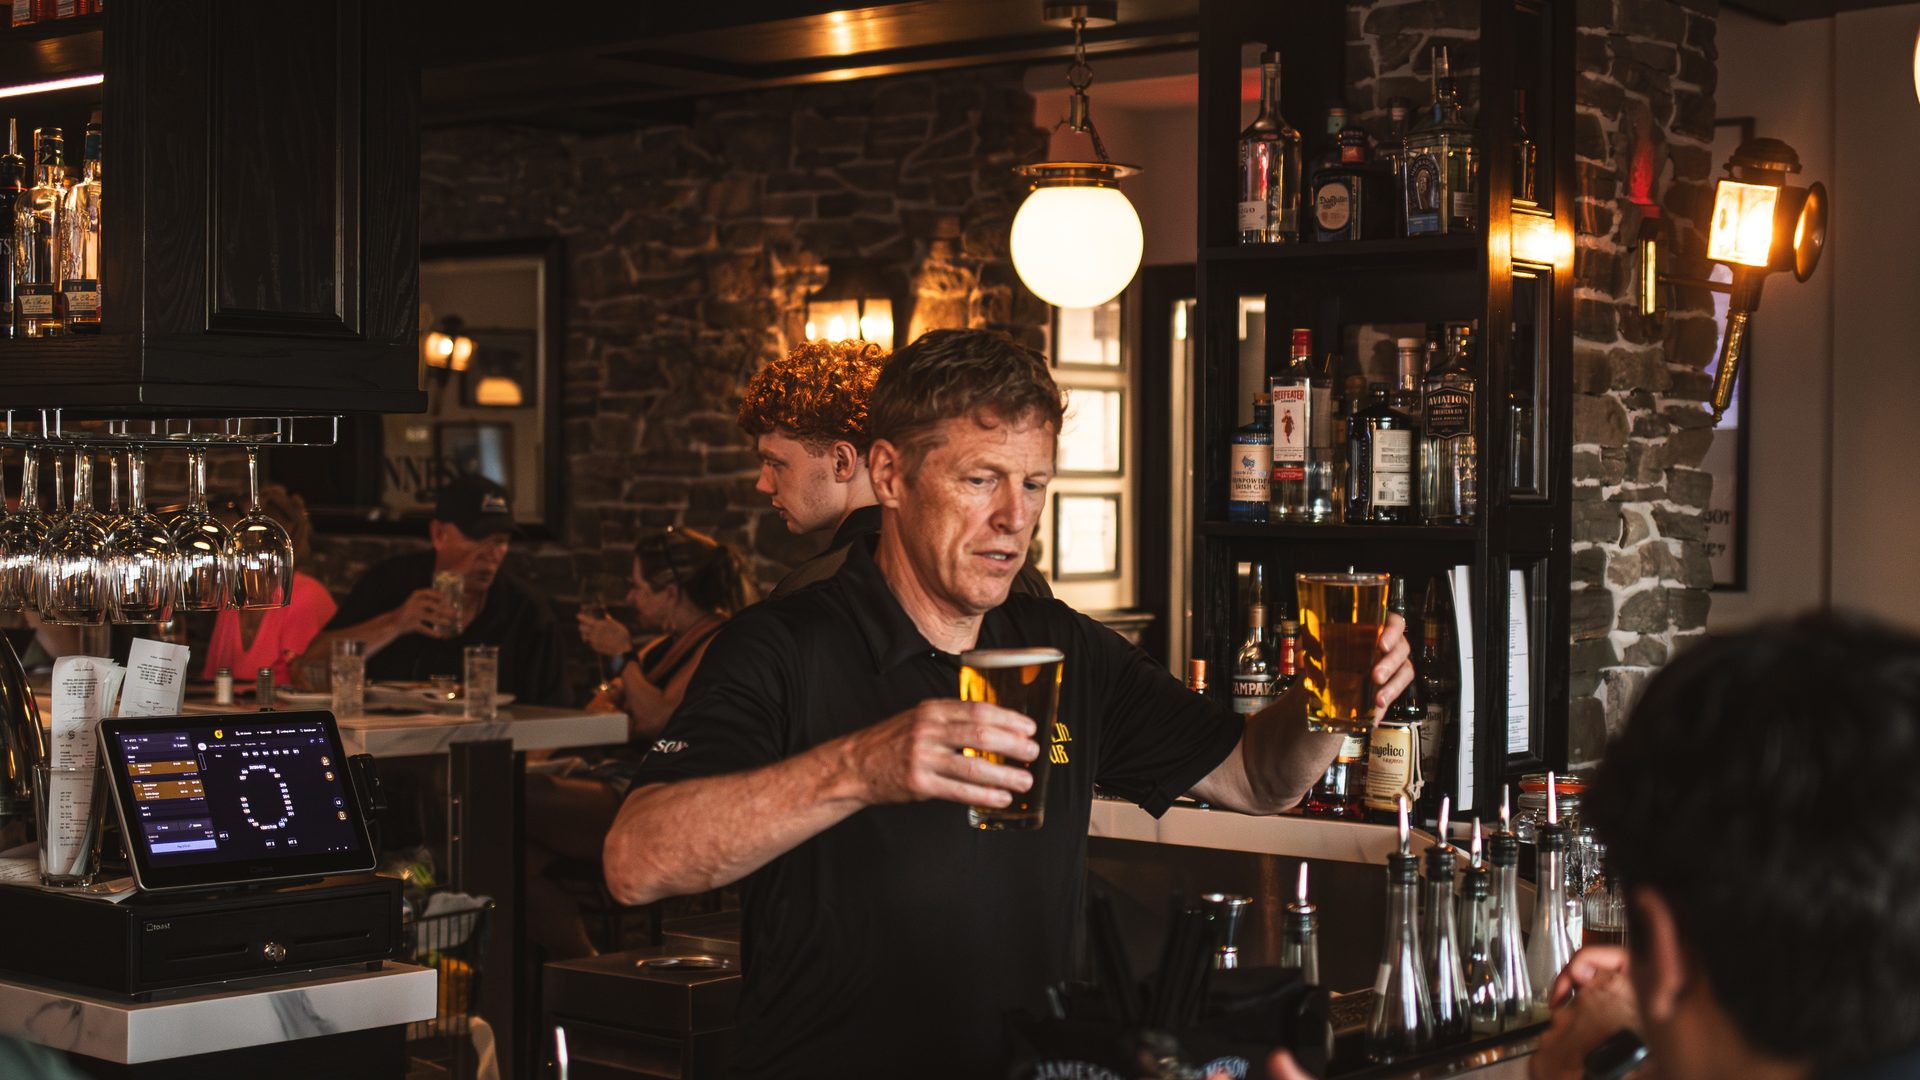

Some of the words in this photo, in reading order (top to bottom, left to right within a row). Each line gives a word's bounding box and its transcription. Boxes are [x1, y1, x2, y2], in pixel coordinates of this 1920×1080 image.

[1274, 389, 1305, 402] BEEFEATER
[1429, 395, 1469, 405] AVIATION
[153, 922, 171, 931] toast
